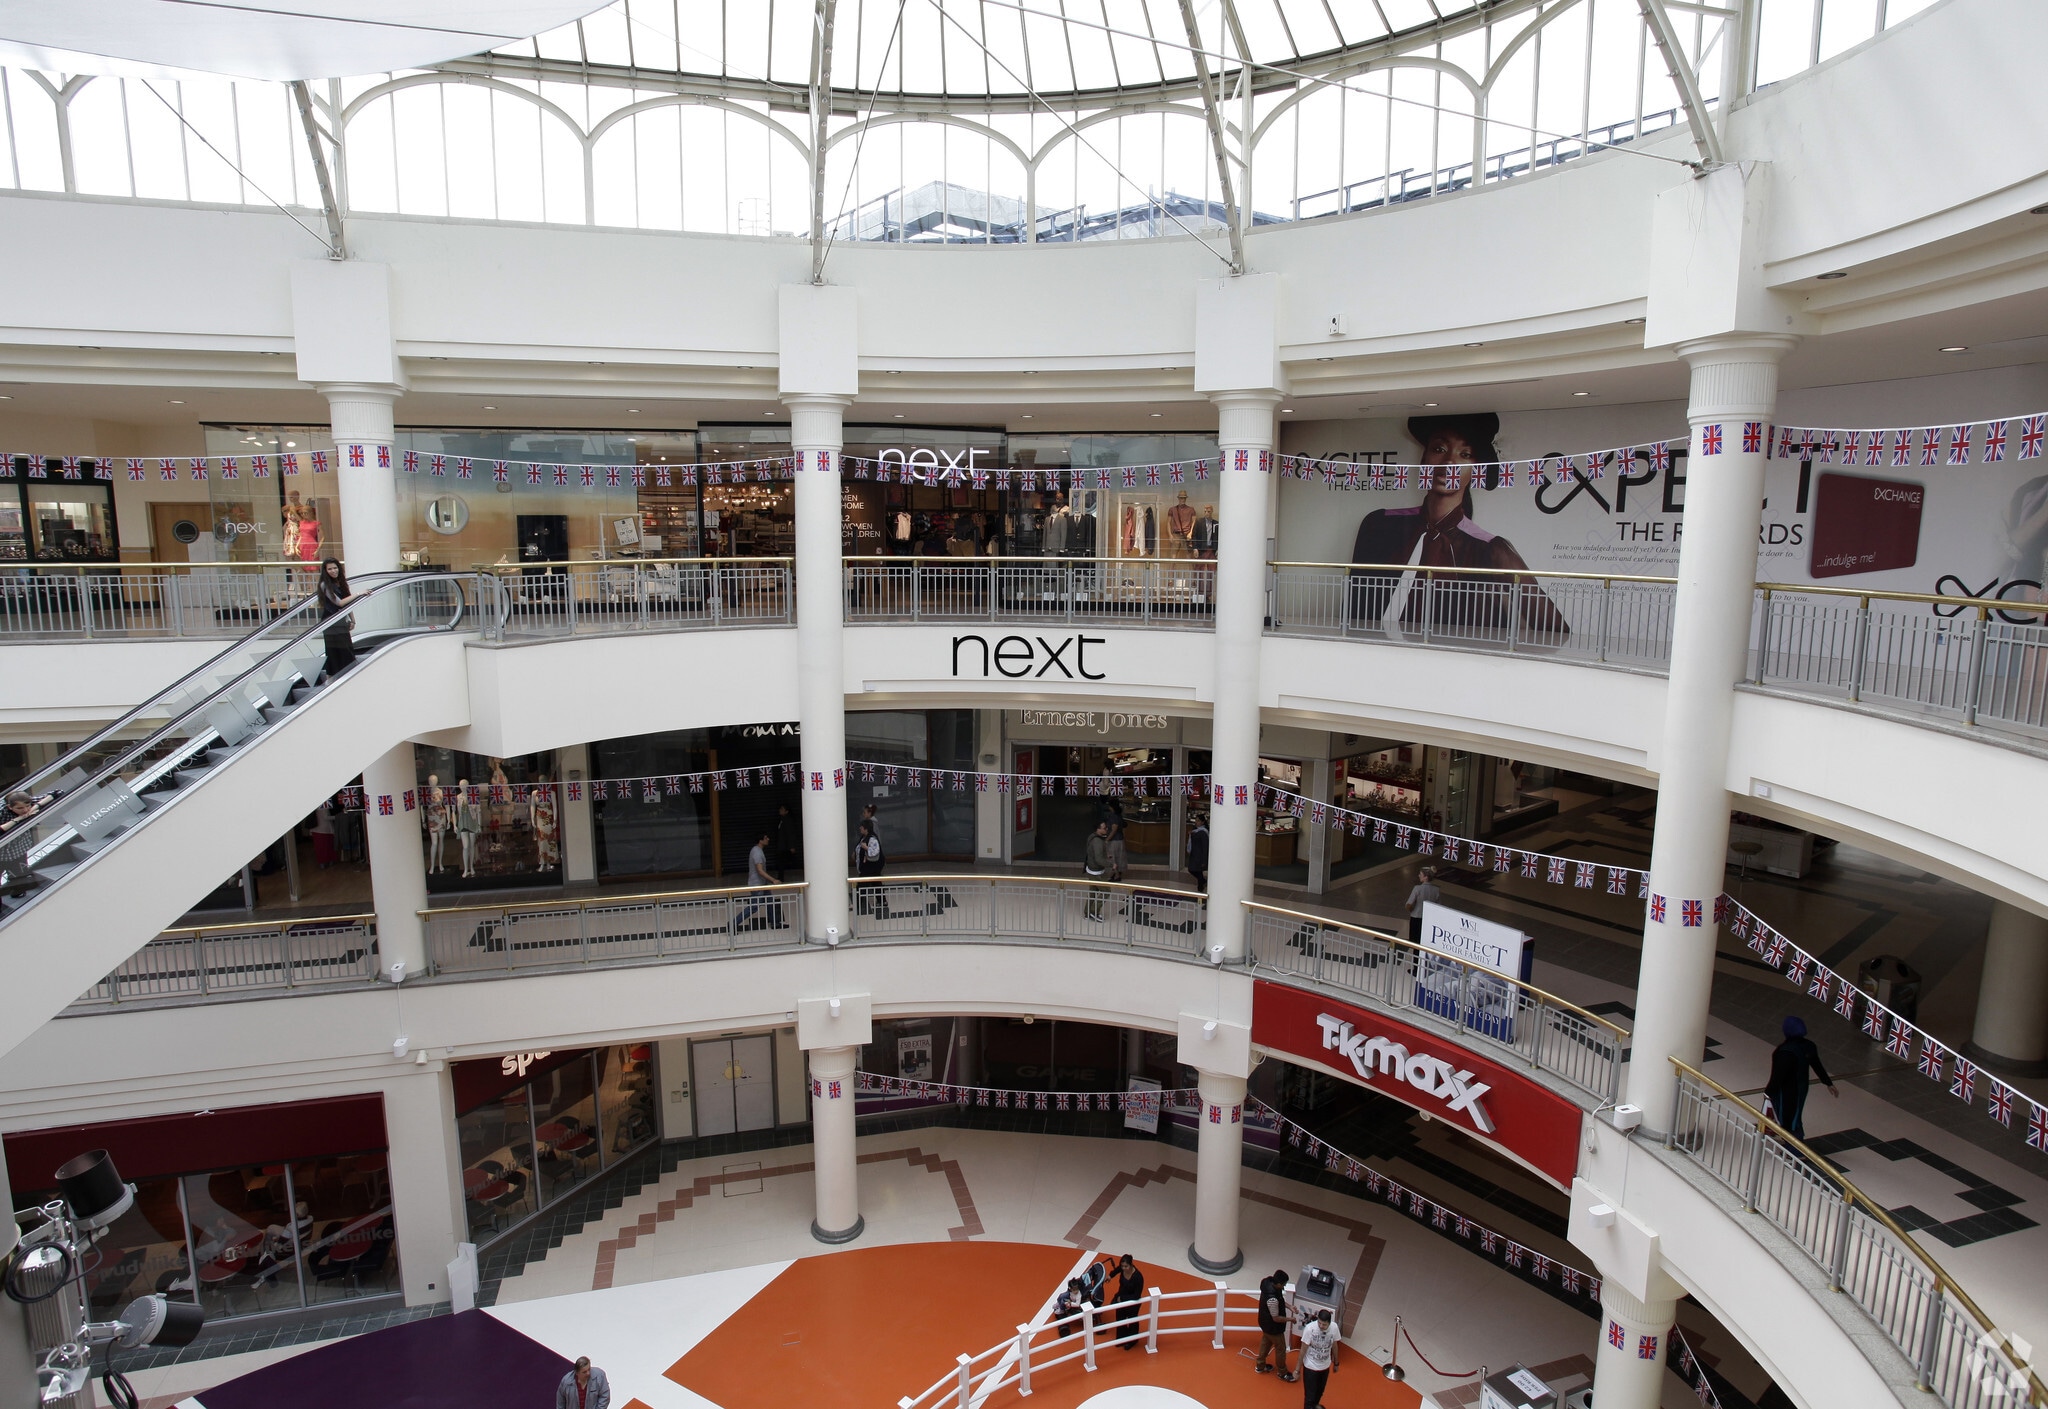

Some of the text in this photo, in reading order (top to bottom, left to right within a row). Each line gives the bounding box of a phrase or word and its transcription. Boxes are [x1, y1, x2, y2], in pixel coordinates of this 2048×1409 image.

[878, 447, 990, 480] next
[225, 522, 267, 534] next
[1616, 521, 1665, 542] THE
[1553, 543, 1569, 551] Have
[1583, 544, 1611, 552] indulged
[1612, 545, 1639, 553] yourself
[1765, 549, 1783, 557] door
[1633, 555, 1664, 563] exclusive
[952, 634, 1106, 680] next
[1020, 709, 1168, 734] Ernest Jones
[80, 793, 130, 829] WHSmith
[1431, 924, 1508, 968] PROTECT
[1442, 942, 1492, 965] YOUR FAMILY
[912, 1039, 931, 1048] EXTRA
[1016, 1065, 1097, 1081] GAME
